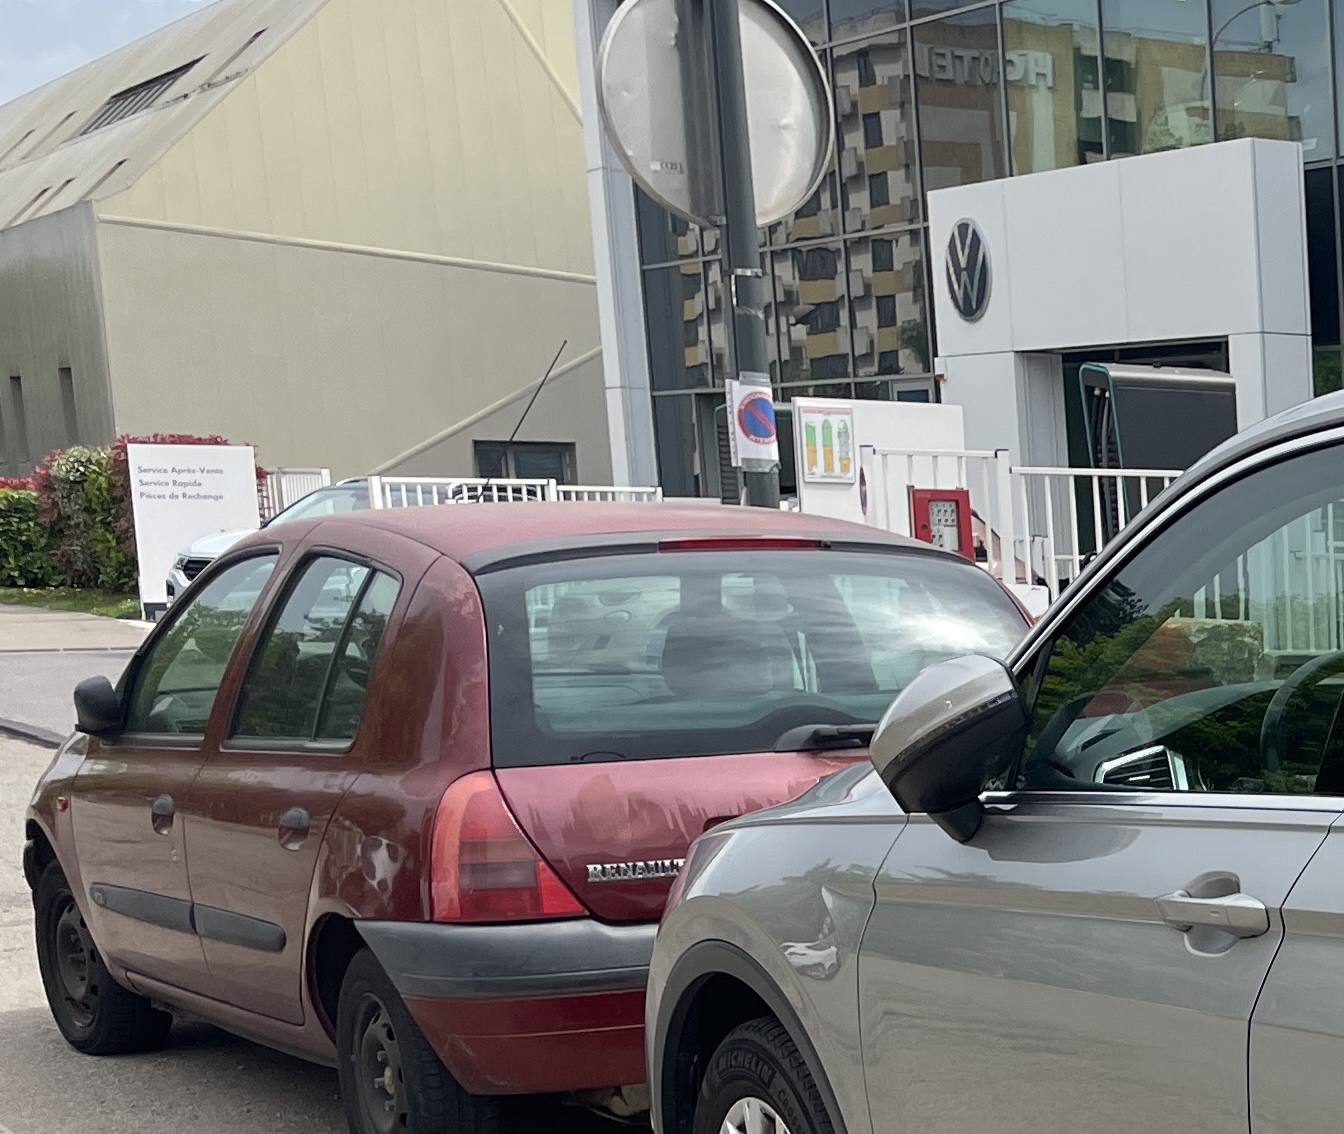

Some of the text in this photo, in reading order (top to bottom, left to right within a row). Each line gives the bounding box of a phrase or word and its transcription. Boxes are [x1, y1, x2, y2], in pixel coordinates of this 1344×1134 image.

[137, 465, 168, 475] Service
[139, 479, 202, 488] Service Rapide
[168, 491, 179, 500] de
[182, 491, 224, 502] Rechange
[586, 858, 686, 883] RENAULT
